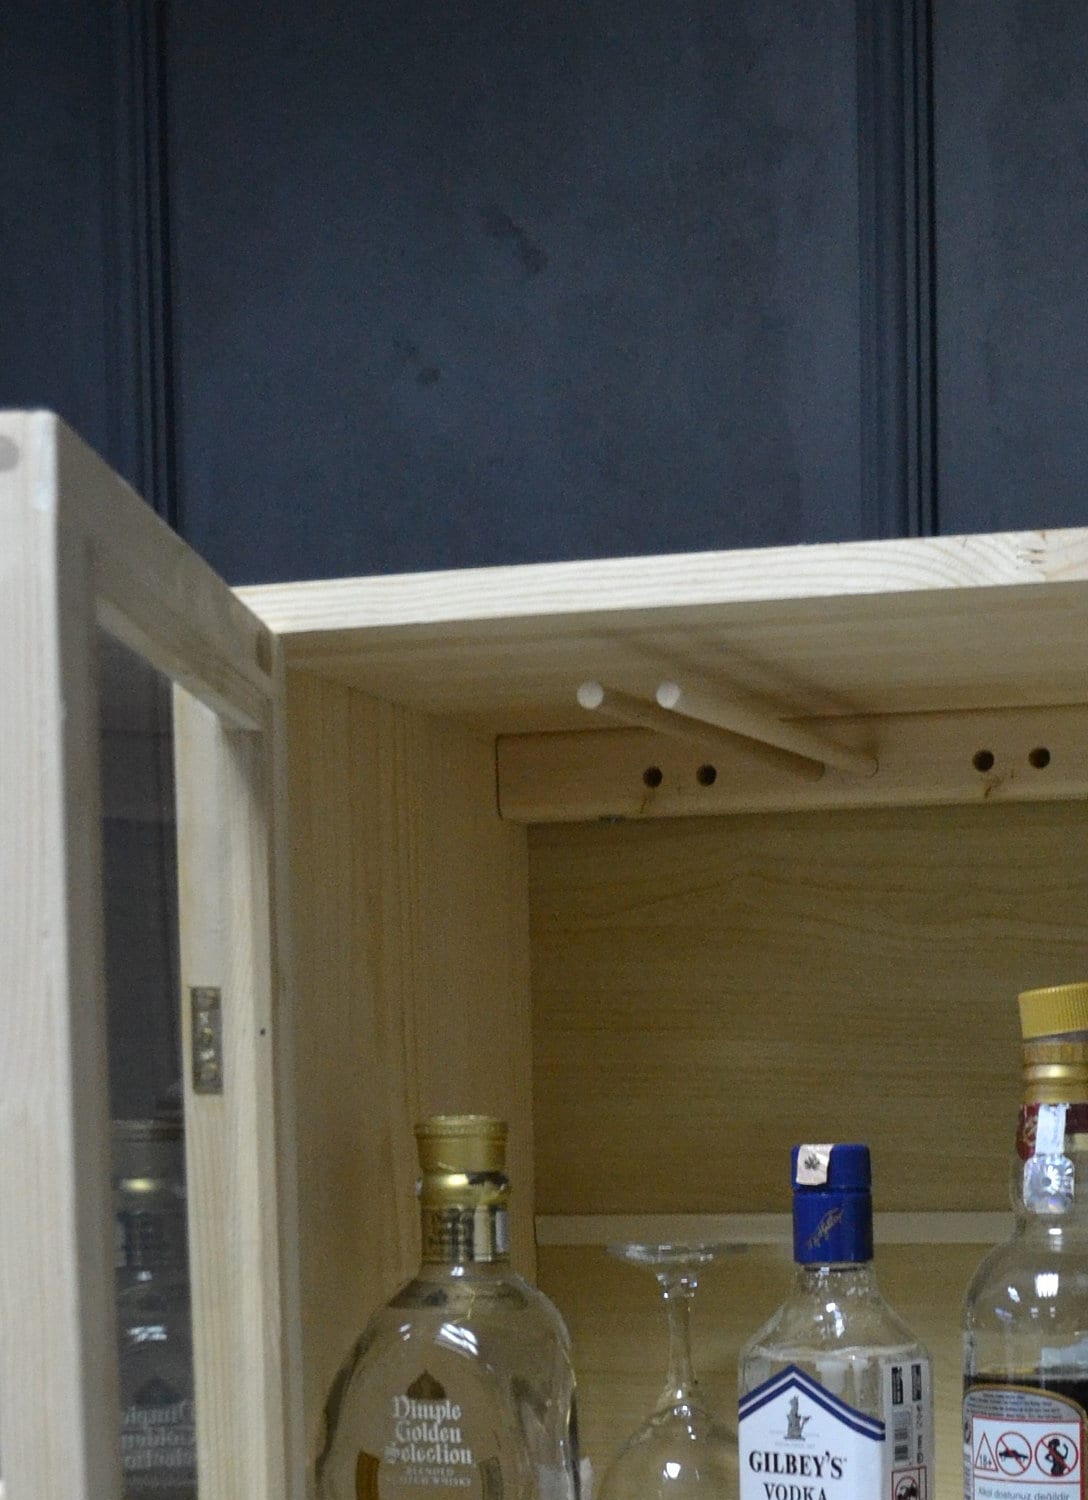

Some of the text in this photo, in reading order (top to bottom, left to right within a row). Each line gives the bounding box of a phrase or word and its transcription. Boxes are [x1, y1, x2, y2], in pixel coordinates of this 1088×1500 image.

[392, 1394, 462, 1423] Dimple
[395, 1420, 462, 1443] Golden
[383, 1440, 473, 1465] Selection
[749, 1450, 843, 1480] GILBEY'S
